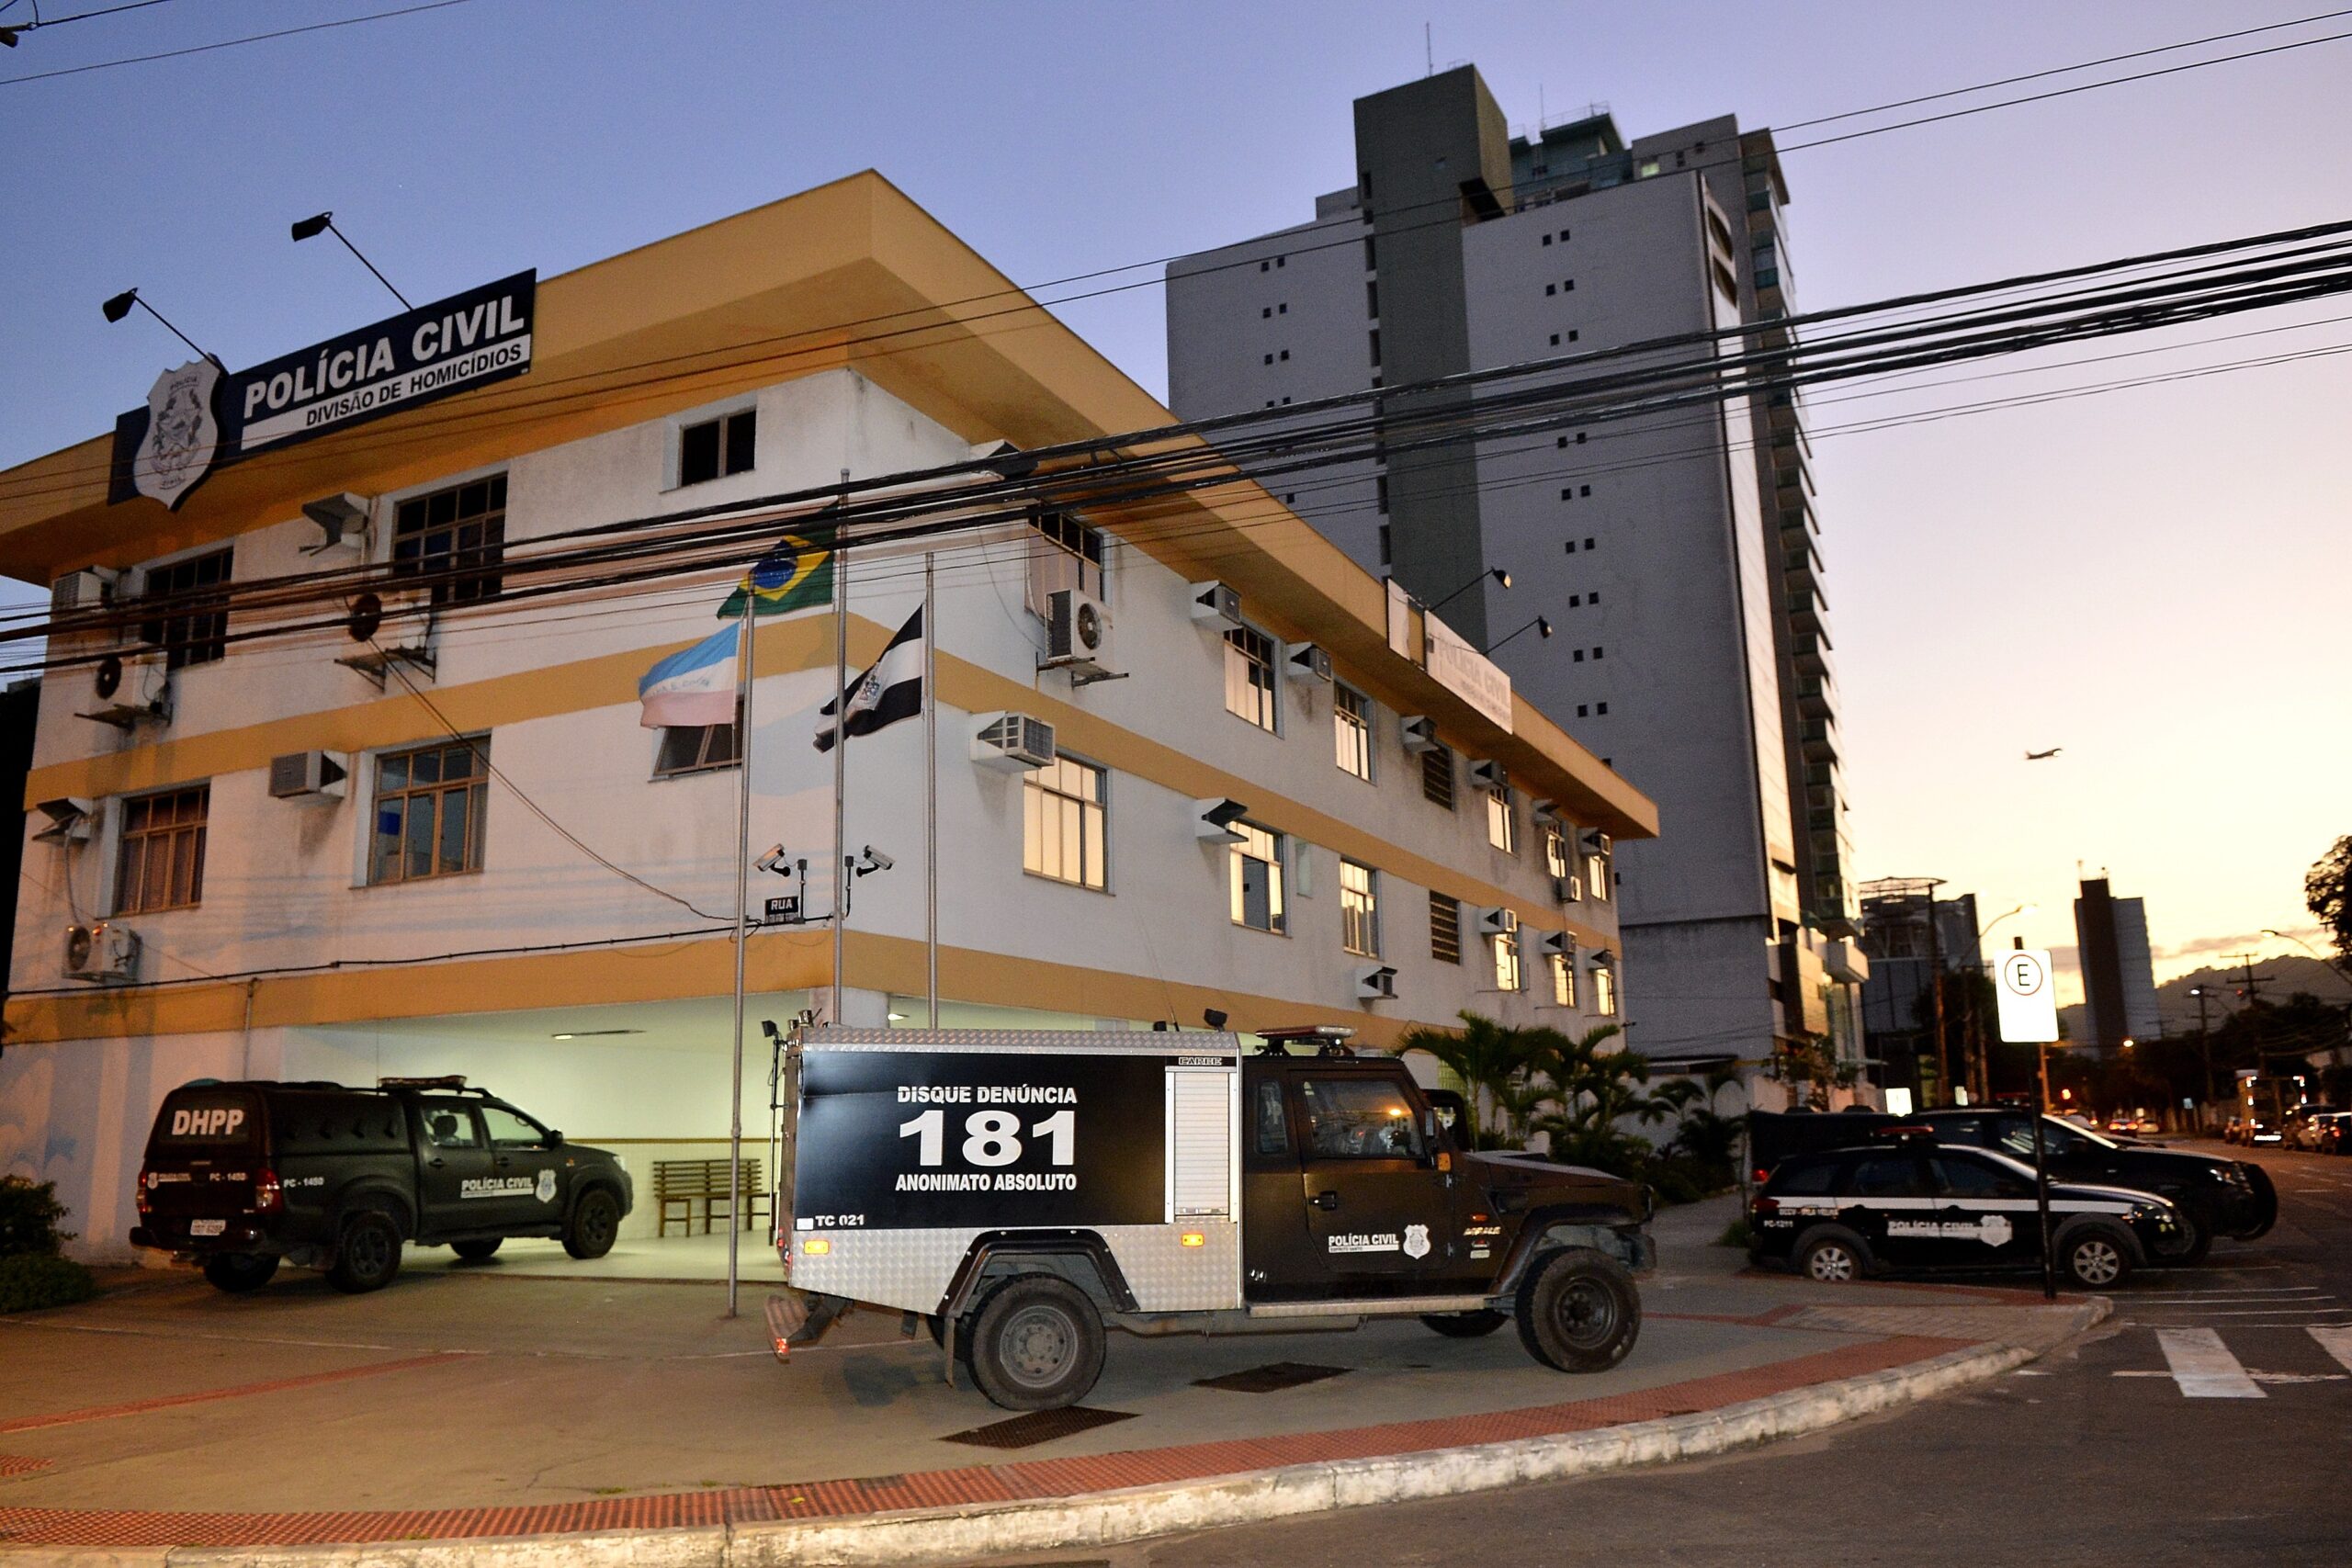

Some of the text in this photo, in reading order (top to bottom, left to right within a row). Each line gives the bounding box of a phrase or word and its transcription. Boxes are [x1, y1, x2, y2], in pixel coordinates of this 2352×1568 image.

[243, 295, 525, 419] POLÍCIA CIVIL
[306, 343, 523, 426] DIVISÃO DE HOMICÍDIOS
[771, 897, 793, 910] RUA
[2017, 964, 2030, 987] E
[897, 1083, 1078, 1104] DISQUE DENÚNCIA
[171, 1109, 244, 1135] DHPP
[899, 1110, 1076, 1168] 181
[461, 1177, 534, 1190] POLÍCIA CIVIL
[895, 1173, 1078, 1191] ANONIMATO ABSOLUTO
[815, 1213, 865, 1227] TC 021
[1887, 1220, 1939, 1232] POLÍCIA
[1328, 1233, 1399, 1247] POLÍCIA CIVIL
